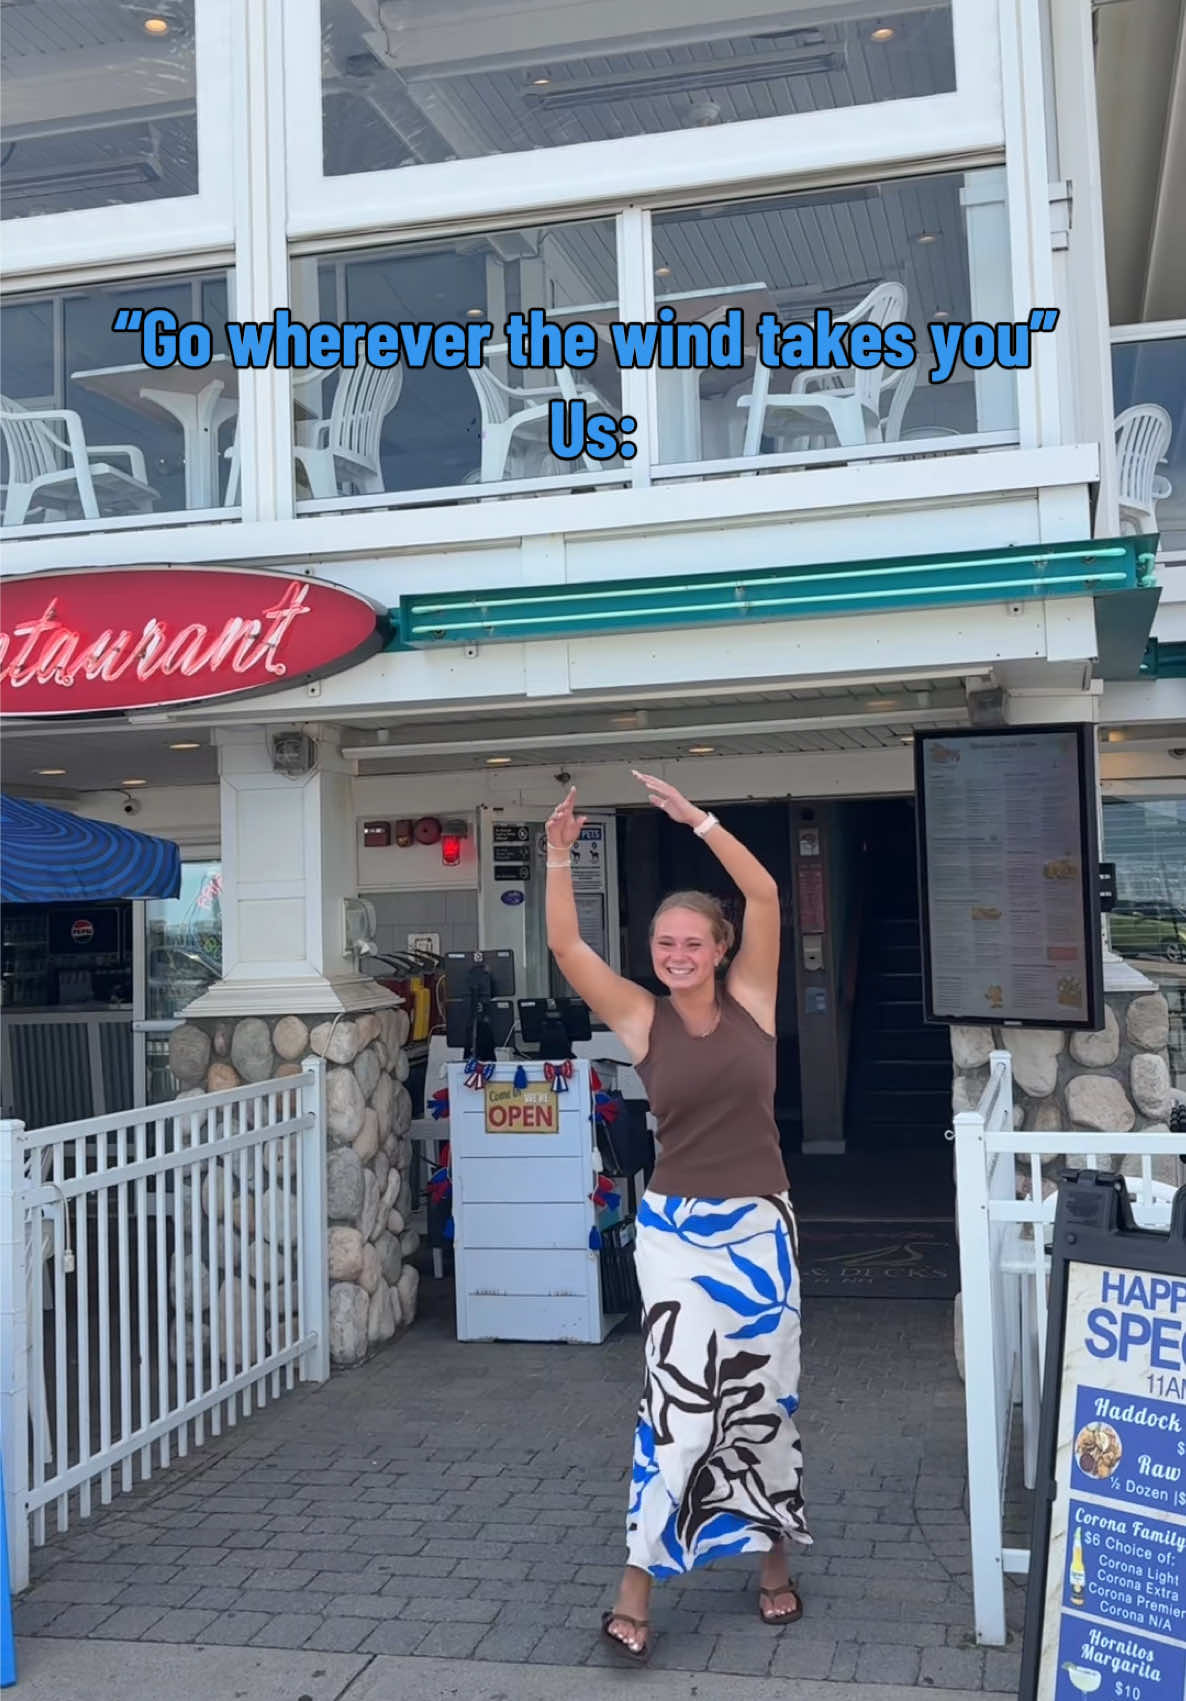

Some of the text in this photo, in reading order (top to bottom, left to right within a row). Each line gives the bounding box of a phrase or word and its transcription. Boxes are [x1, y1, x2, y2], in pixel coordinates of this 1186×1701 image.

[488, 1105, 553, 1127] OPEN
[1102, 1271, 1186, 1313] HAPP
[1085, 1308, 1186, 1371] SPE
[1094, 1397, 1182, 1433] Haddock
[1137, 1454, 1181, 1481] Raw
[1125, 1479, 1169, 1502] Dozen
[1075, 1507, 1186, 1553] Corona Family
[1084, 1531, 1176, 1567] $6 Choice of:
[1097, 1569, 1180, 1601] Corona Extra
[1099, 1554, 1180, 1586] Corona Light
[1088, 1582, 1186, 1619] Corona Premier
[1100, 1600, 1173, 1632] Corona N/A
[1089, 1628, 1155, 1662] Hornitos
[1081, 1643, 1161, 1682] Margarita
[1115, 1681, 1141, 1701] $10
